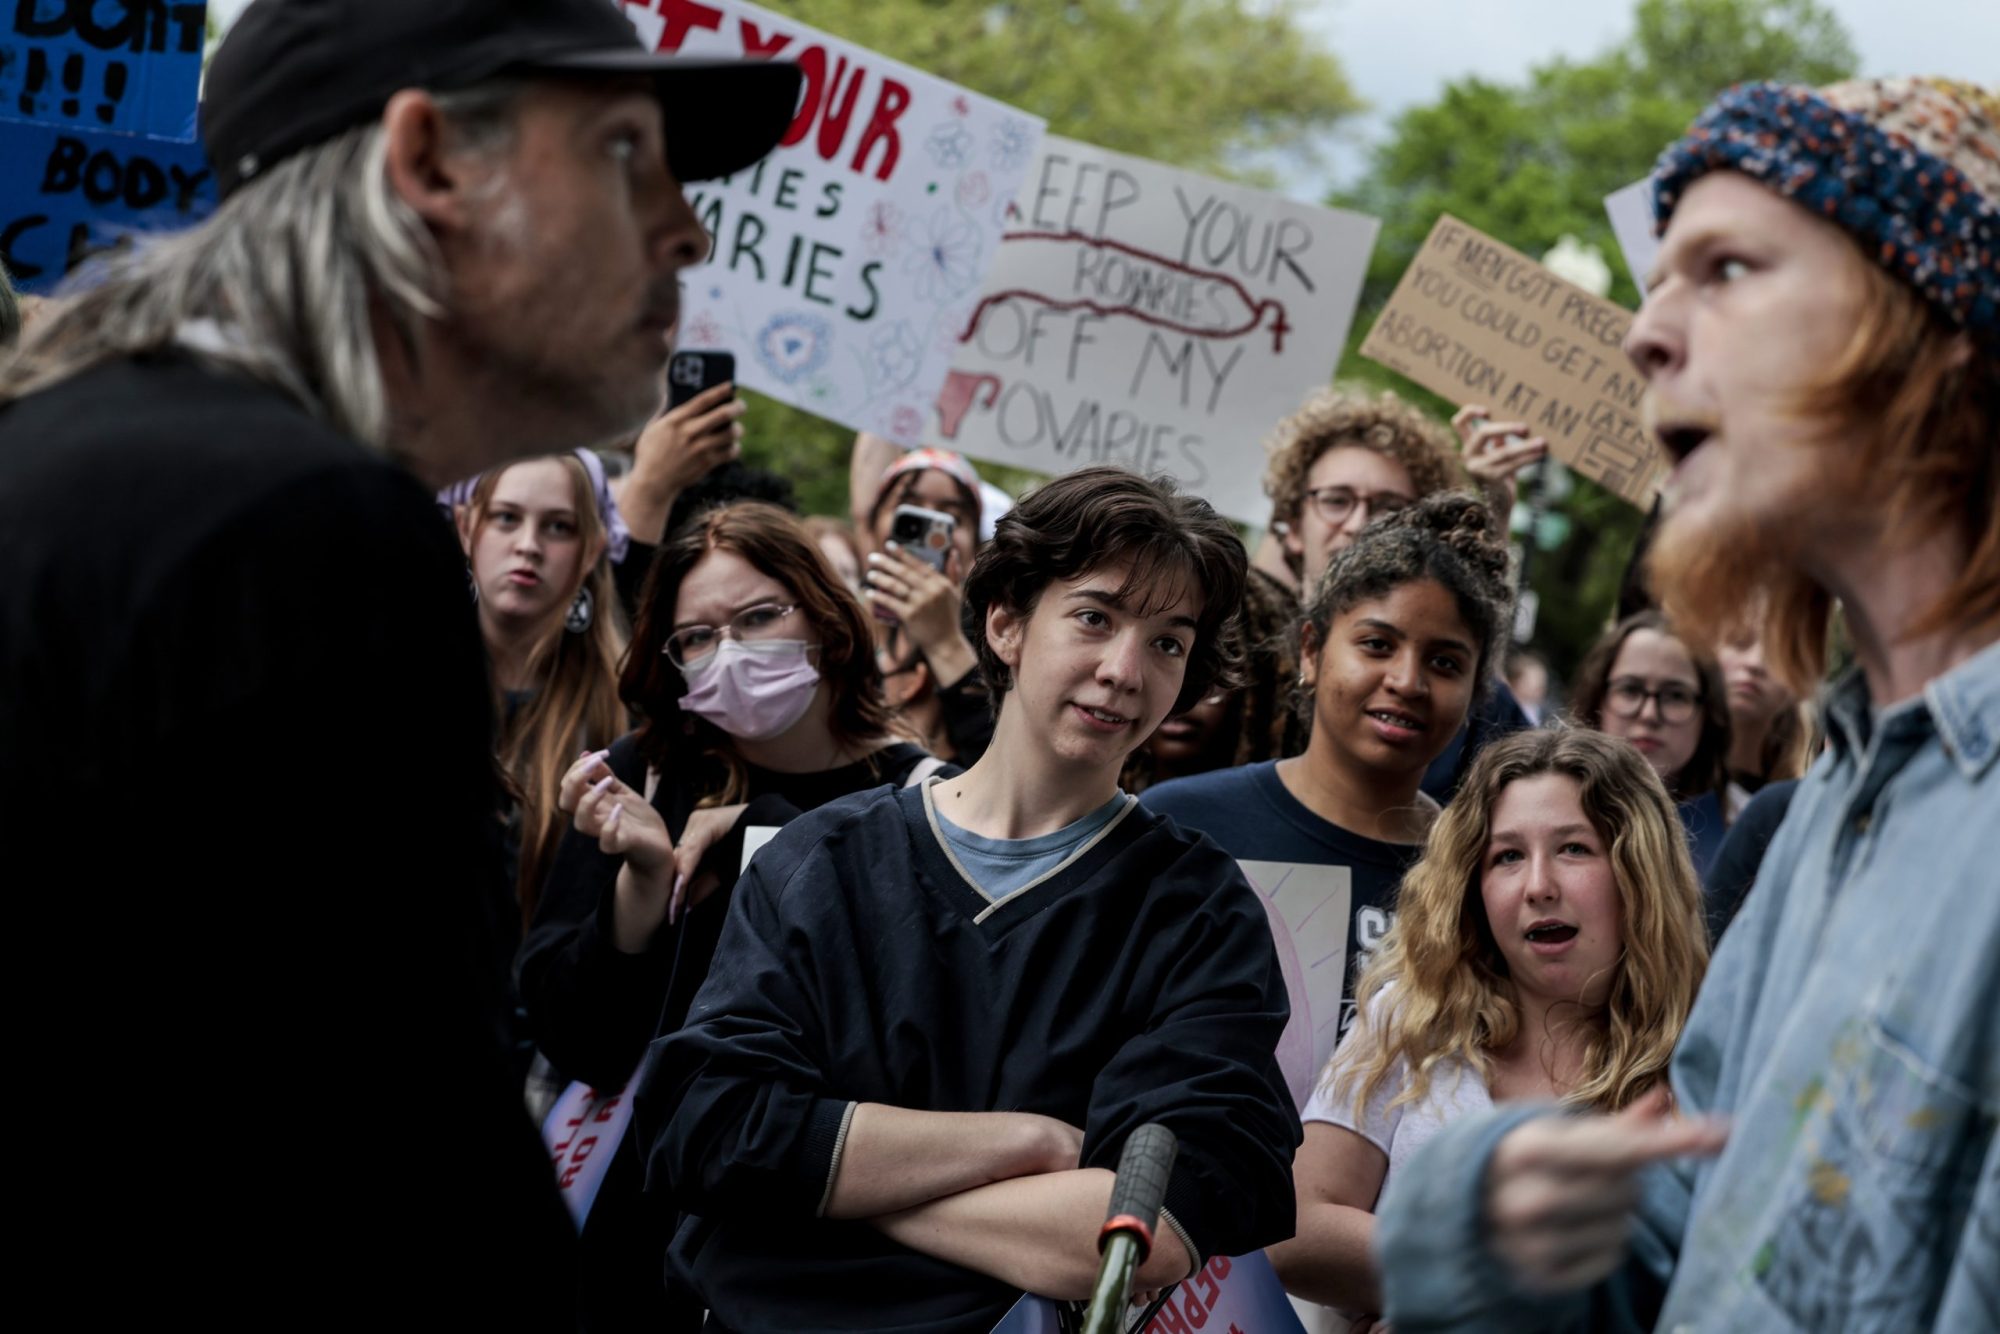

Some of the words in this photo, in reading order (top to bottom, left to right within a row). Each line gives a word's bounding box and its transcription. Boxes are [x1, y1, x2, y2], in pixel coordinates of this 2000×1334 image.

[41, 136, 209, 214] BODY
[1032, 153, 1141, 240] EEP
[1174, 184, 1317, 294] YOUR
[1411, 263, 1459, 309] YOU
[1460, 294, 1543, 349] COULD
[1542, 337, 1605, 384] GET
[1601, 371, 1646, 410] AN
[1433, 223, 1463, 251] IF
[1504, 262, 1561, 309] GOT
[1558, 293, 1629, 349] PREG
[977, 298, 1107, 382] OFF
[1130, 329, 1246, 416] MY
[1378, 308, 1506, 398] ABORTION
[1502, 381, 1540, 416] AT
[1538, 400, 1584, 438] AN
[996, 380, 1211, 490] OVARIES
